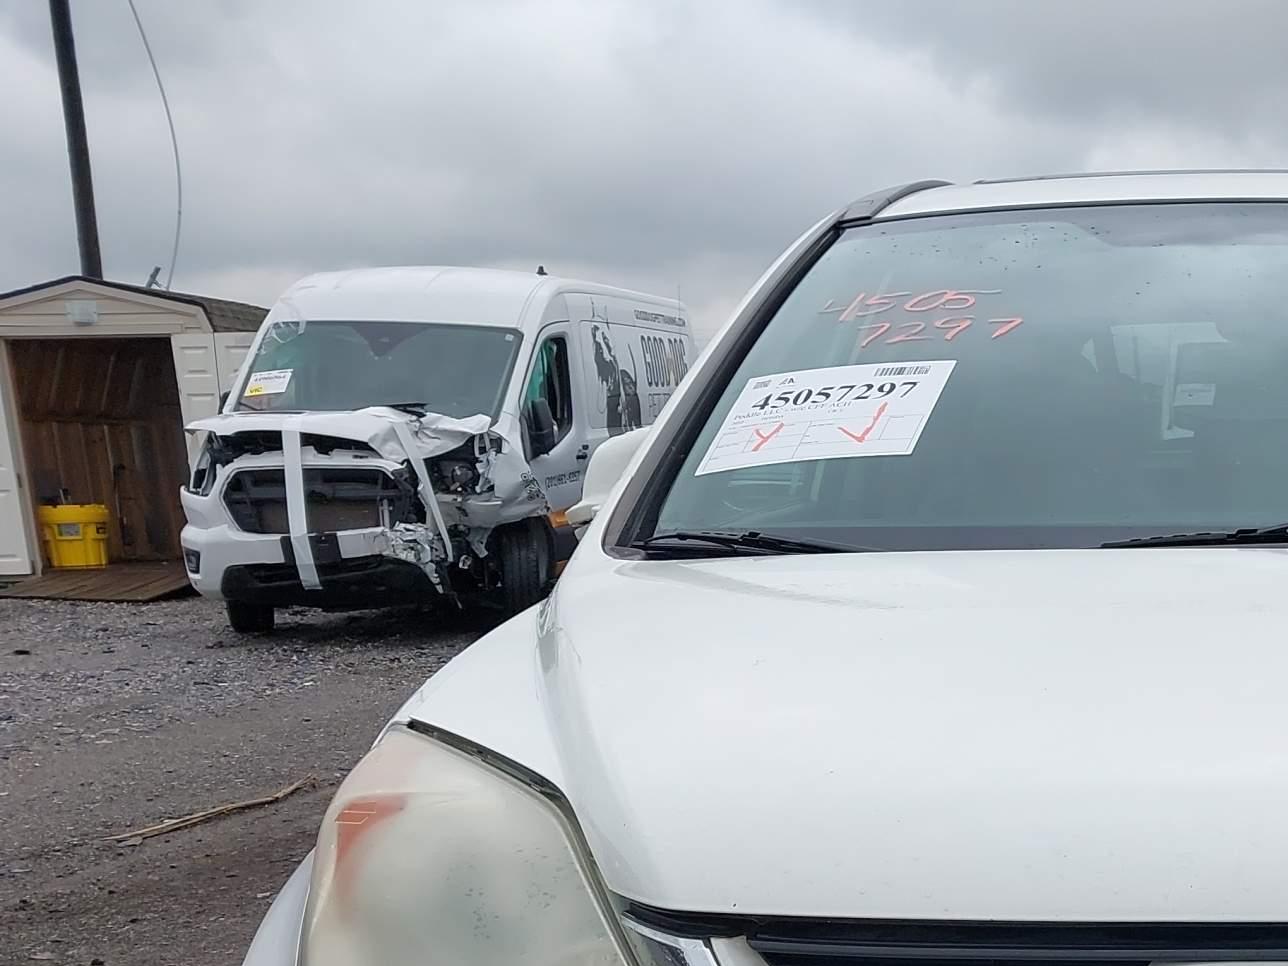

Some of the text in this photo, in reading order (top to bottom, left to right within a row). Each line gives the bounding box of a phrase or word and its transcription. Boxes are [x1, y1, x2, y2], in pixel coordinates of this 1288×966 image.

[818, 289, 1003, 322] 4505
[857, 314, 1024, 349] 7297
[640, 334, 671, 388] GOOD
[752, 381, 920, 410] 45057297
